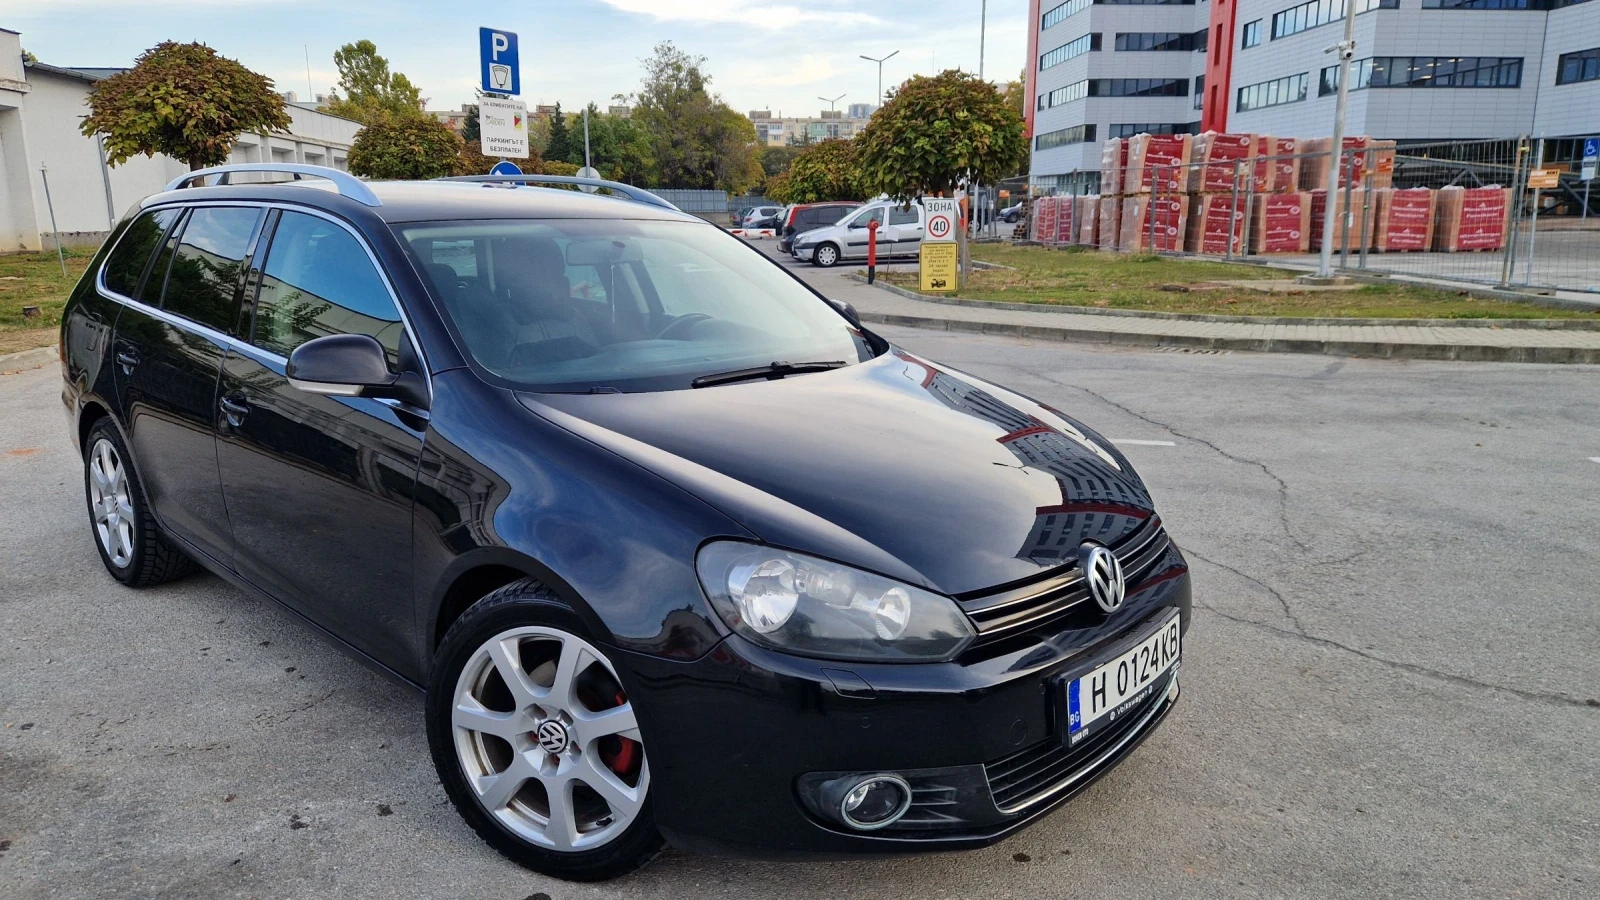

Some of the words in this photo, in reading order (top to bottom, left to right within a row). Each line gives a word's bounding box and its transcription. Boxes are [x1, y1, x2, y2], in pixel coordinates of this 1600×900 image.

[492, 32, 508, 61] P
[486, 137, 519, 145] ПАРКИНГЪТ
[489, 146, 522, 154] БЕЗПЛАТЕН
[928, 202, 953, 212] ЗОНА
[933, 220, 946, 232] 40
[1092, 671, 1106, 714] H
[1116, 690, 1148, 715] Volkswagen
[1069, 711, 1080, 726] BG
